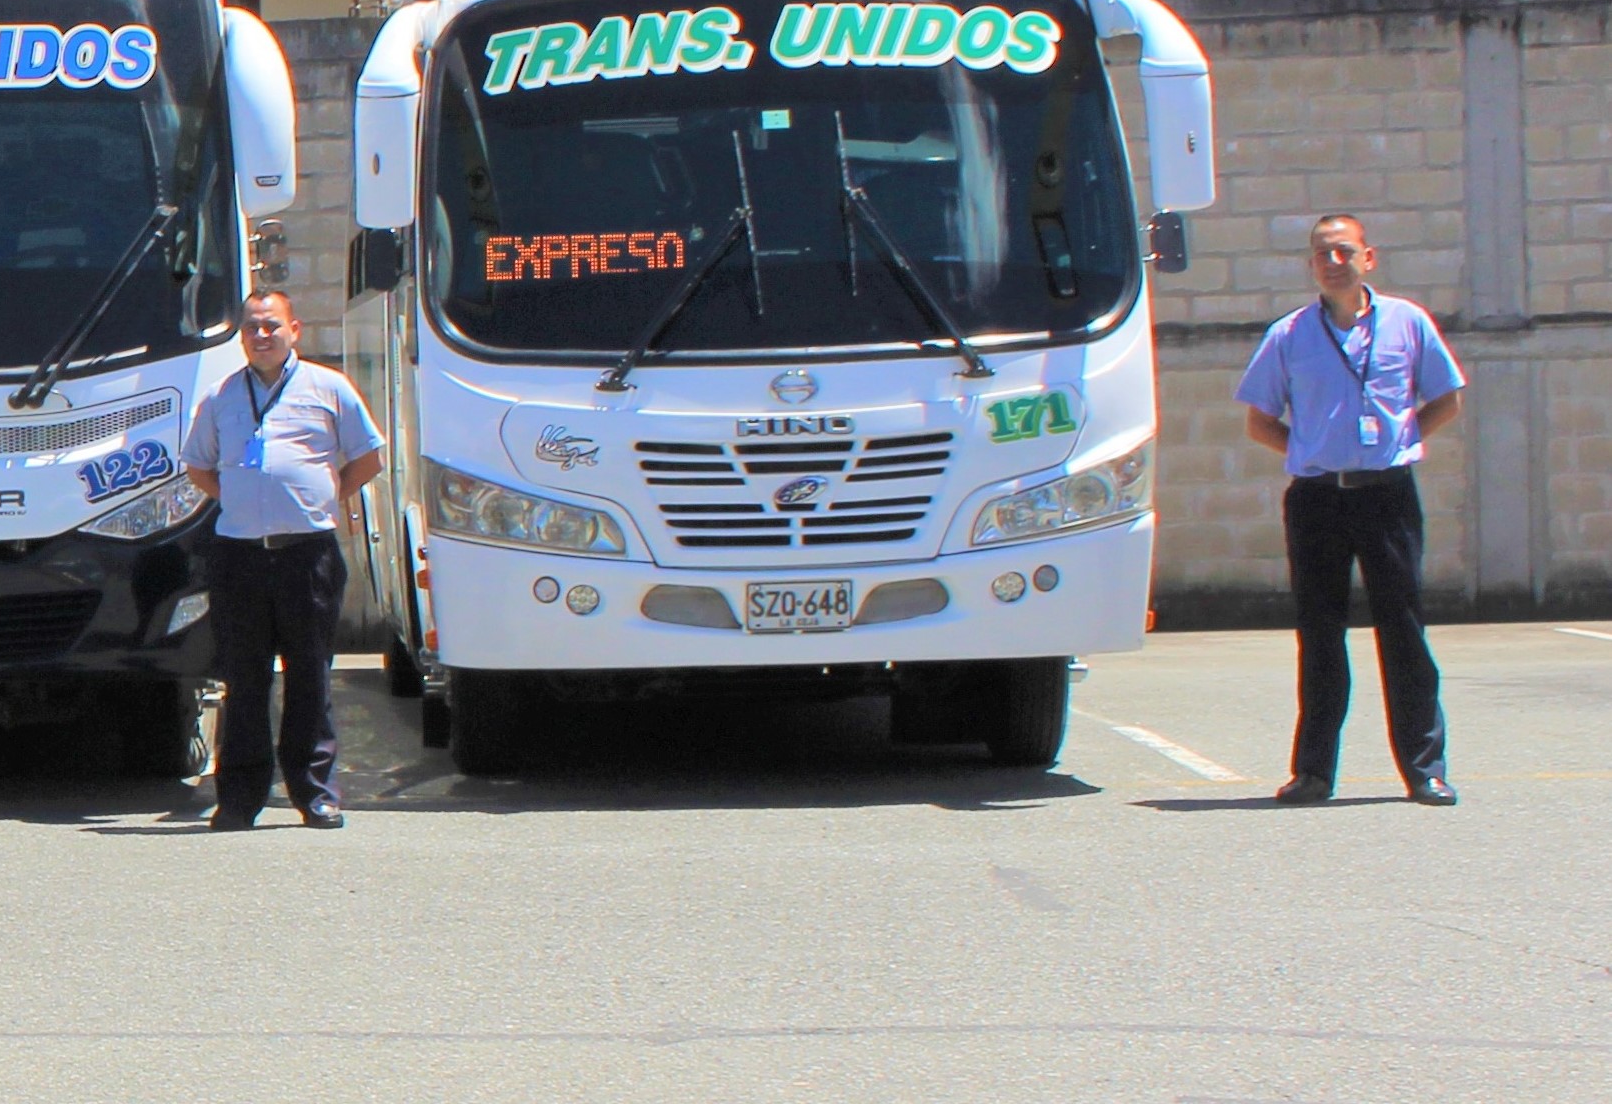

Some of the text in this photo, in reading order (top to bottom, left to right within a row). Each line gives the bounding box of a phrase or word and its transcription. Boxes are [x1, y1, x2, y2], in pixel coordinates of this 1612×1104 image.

[482, 3, 1061, 95] TRANS. UNIDOS
[736, 414, 856, 437] HINO
[986, 391, 1076, 445] 171
[77, 439, 172, 504] 122
